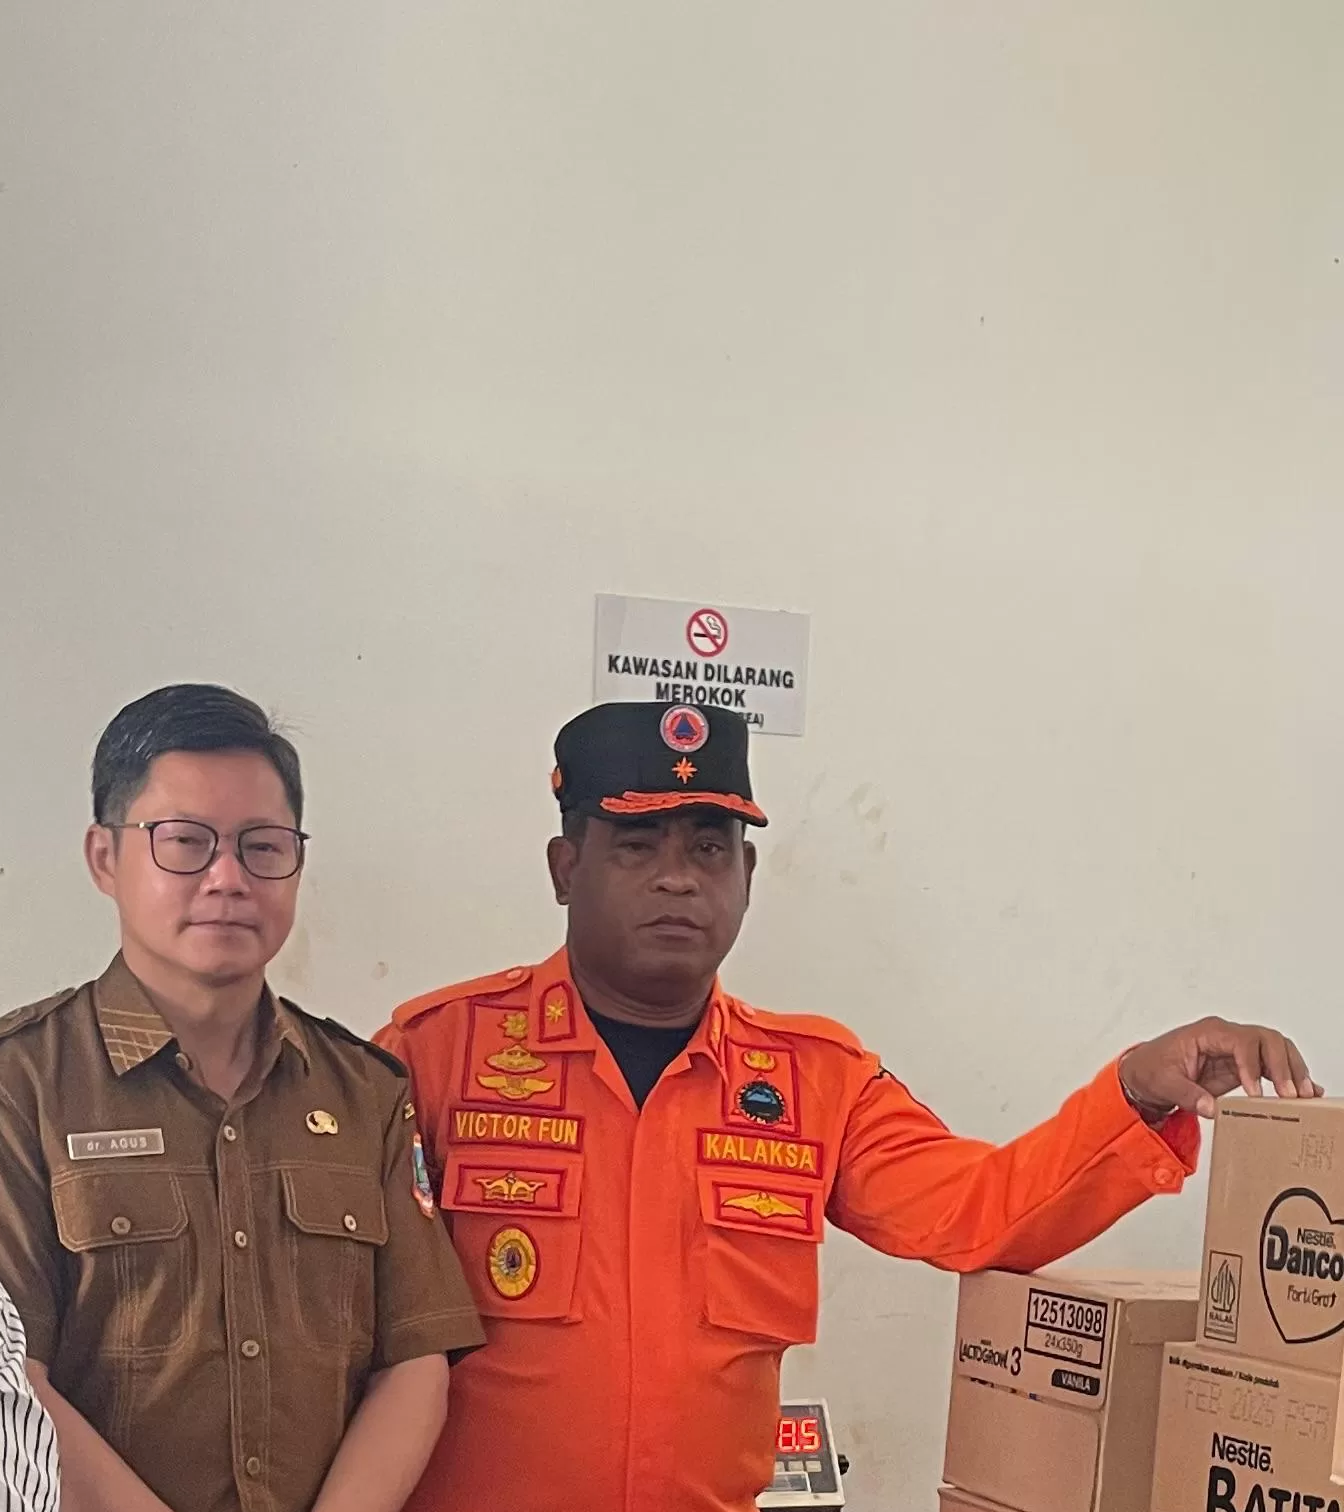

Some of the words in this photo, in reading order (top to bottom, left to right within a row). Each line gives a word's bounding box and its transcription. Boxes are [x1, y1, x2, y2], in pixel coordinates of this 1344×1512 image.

[608, 654, 698, 682] KAWASAN
[703, 663, 795, 689] DILARANG
[655, 681, 746, 708] MEROKOK
[109, 1136, 148, 1150] AGUS
[455, 1110, 532, 1141] VICTOR
[538, 1115, 579, 1146] FUN
[703, 1133, 816, 1171] KALAKSA
[1031, 1296, 1104, 1335] 12513098
[1009, 1346, 1023, 1377] 3
